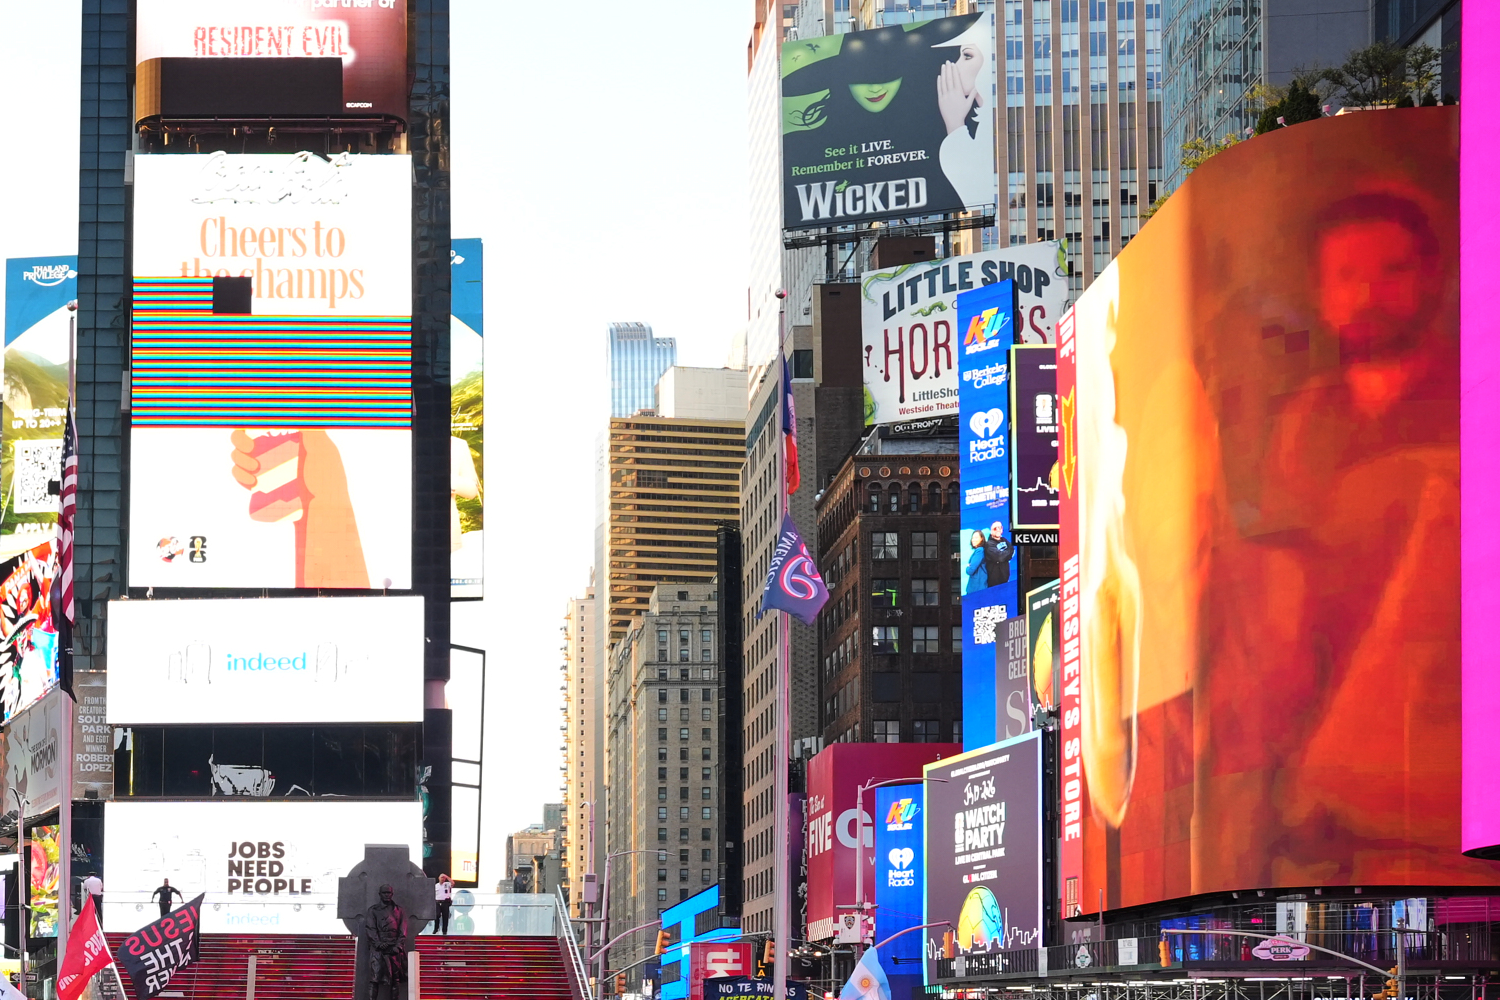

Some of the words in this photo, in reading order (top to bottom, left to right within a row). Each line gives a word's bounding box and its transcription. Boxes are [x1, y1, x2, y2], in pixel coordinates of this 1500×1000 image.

[194, 26, 294, 56] RESIDENT
[302, 26, 348, 56] EVIL
[825, 146, 847, 158] See
[849, 145, 859, 155] it
[861, 139, 895, 153] LIVE.
[791, 158, 853, 177] Remember
[855, 156, 865, 169] it
[867, 149, 930, 168] FOREVER.
[199, 216, 308, 259] Cheers
[315, 220, 346, 259] to
[23, 271, 66, 281] PRIVILEGE
[32, 264, 70, 274] THAILAND
[883, 260, 973, 322] LITTLE
[980, 259, 1051, 298] SHOP
[963, 307, 1007, 346] KTU
[971, 362, 1008, 380] Berkeley
[973, 373, 1007, 389] College
[898, 402, 934, 416] Westside
[11, 420, 24, 430] UP
[25, 419, 38, 429] TO
[969, 447, 1005, 464] Radio
[14, 522, 50, 535] APPLY
[227, 652, 307, 672] indeed
[84, 696, 99, 705] FROM
[79, 705, 107, 714] CREATORS
[81, 725, 112, 734] PARK
[83, 735, 94, 743] AND
[95, 734, 110, 744] EGOT
[85, 744, 107, 753] WINNER
[30, 740, 56, 776] MORMON
[76, 753, 115, 763] ROBERT
[80, 763, 113, 772] LOPEZ
[1064, 736, 1080, 842] STORE
[886, 798, 918, 825] KTU
[965, 802, 1006, 829] WATCH
[809, 811, 832, 860] FIVE
[965, 822, 1006, 852] PARTY
[228, 841, 285, 859] JOBS
[228, 859, 284, 878] NEED
[228, 878, 312, 896] PEOPLE
[888, 878, 915, 888] Radio
[226, 912, 280, 926] indeed
[1270, 946, 1292, 954] PERK
[718, 983, 734, 994] NO
[737, 982, 752, 992] TE
